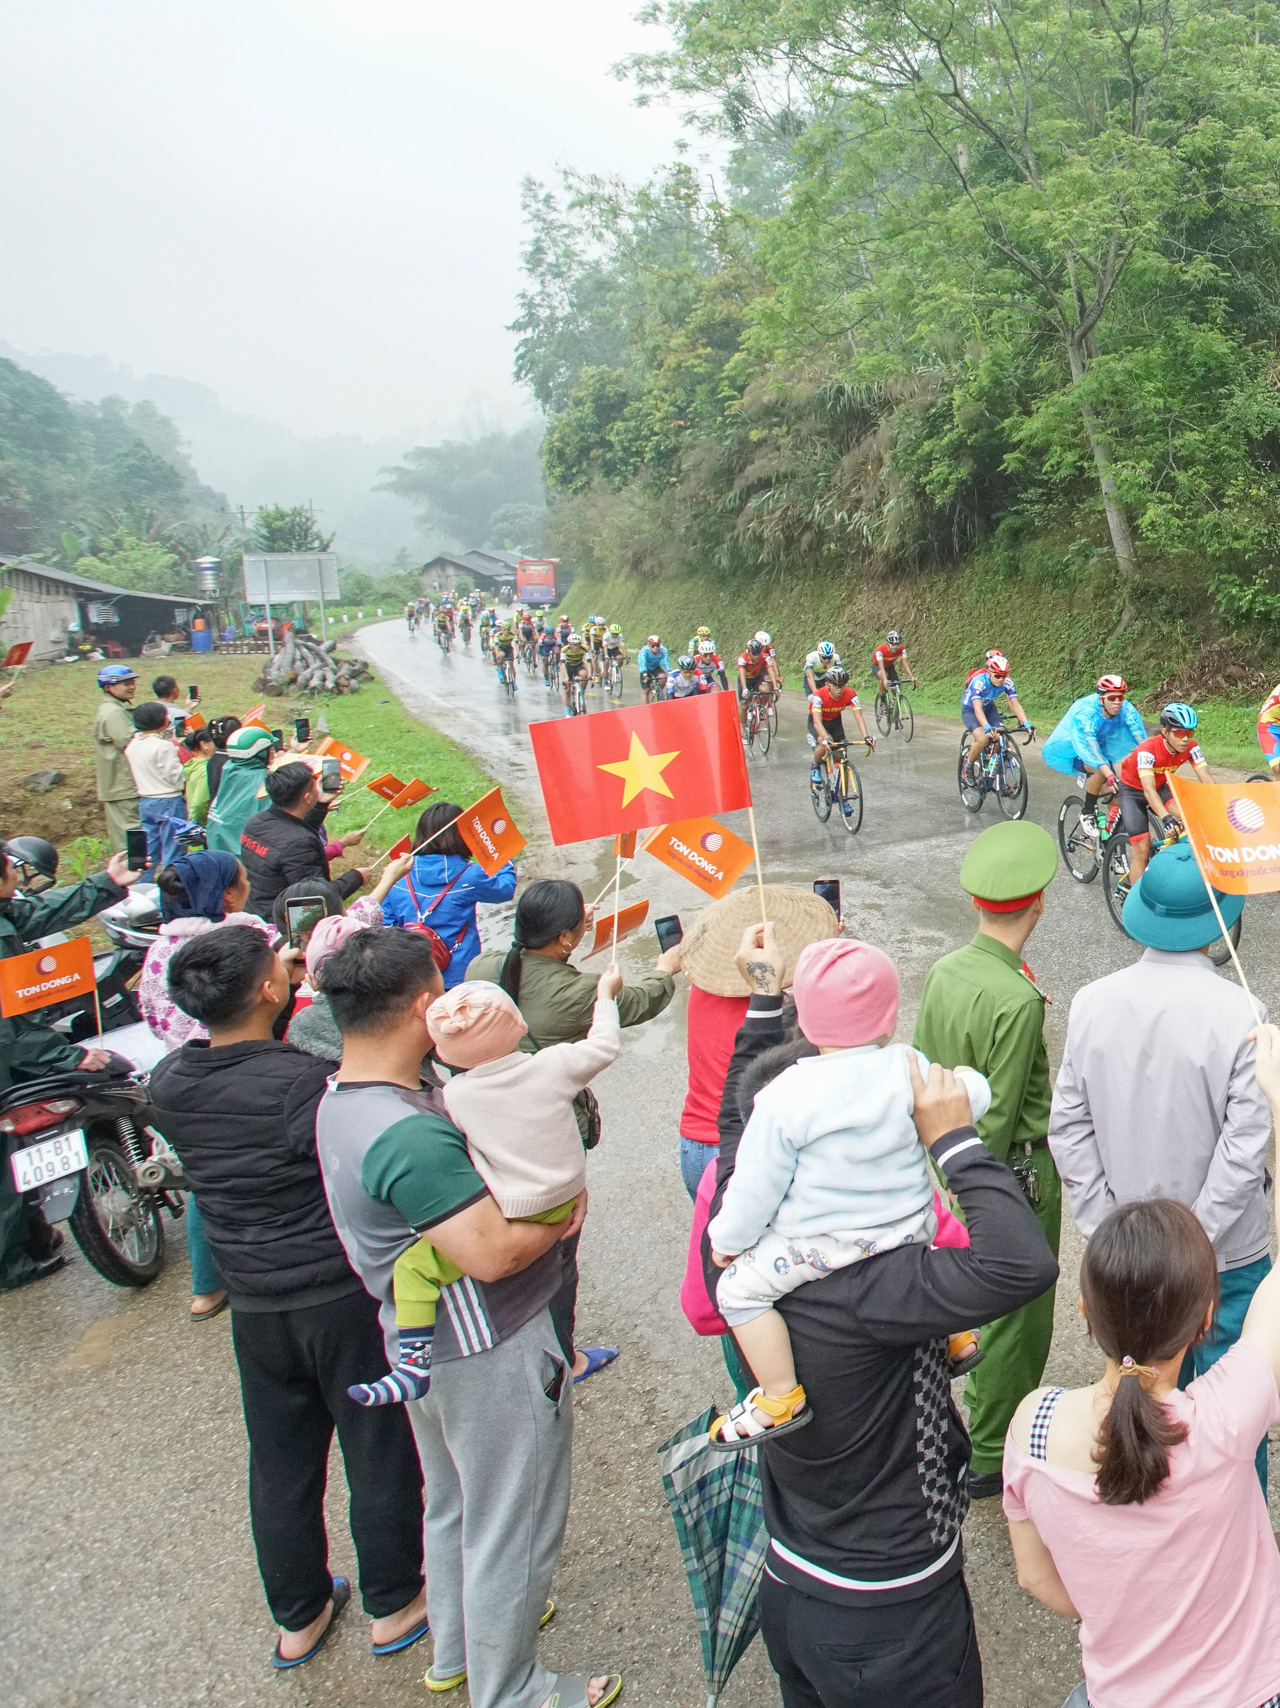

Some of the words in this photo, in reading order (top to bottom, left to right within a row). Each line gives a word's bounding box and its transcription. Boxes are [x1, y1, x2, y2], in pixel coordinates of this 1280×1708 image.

[240, 833, 269, 858] PREME
[472, 816, 483, 834] TON
[479, 831, 496, 853] DONG
[492, 852, 499, 860] A
[668, 836, 690, 856] TON
[688, 851, 718, 875] DONG
[714, 871, 724, 881] A
[1206, 844, 1241, 863] TON
[15, 984, 41, 998] TON
[41, 974, 72, 991] DONG
[71, 972, 81, 981] A
[25, 1136, 73, 1166] 11-B1
[22, 1151, 83, 1186] 409.81
